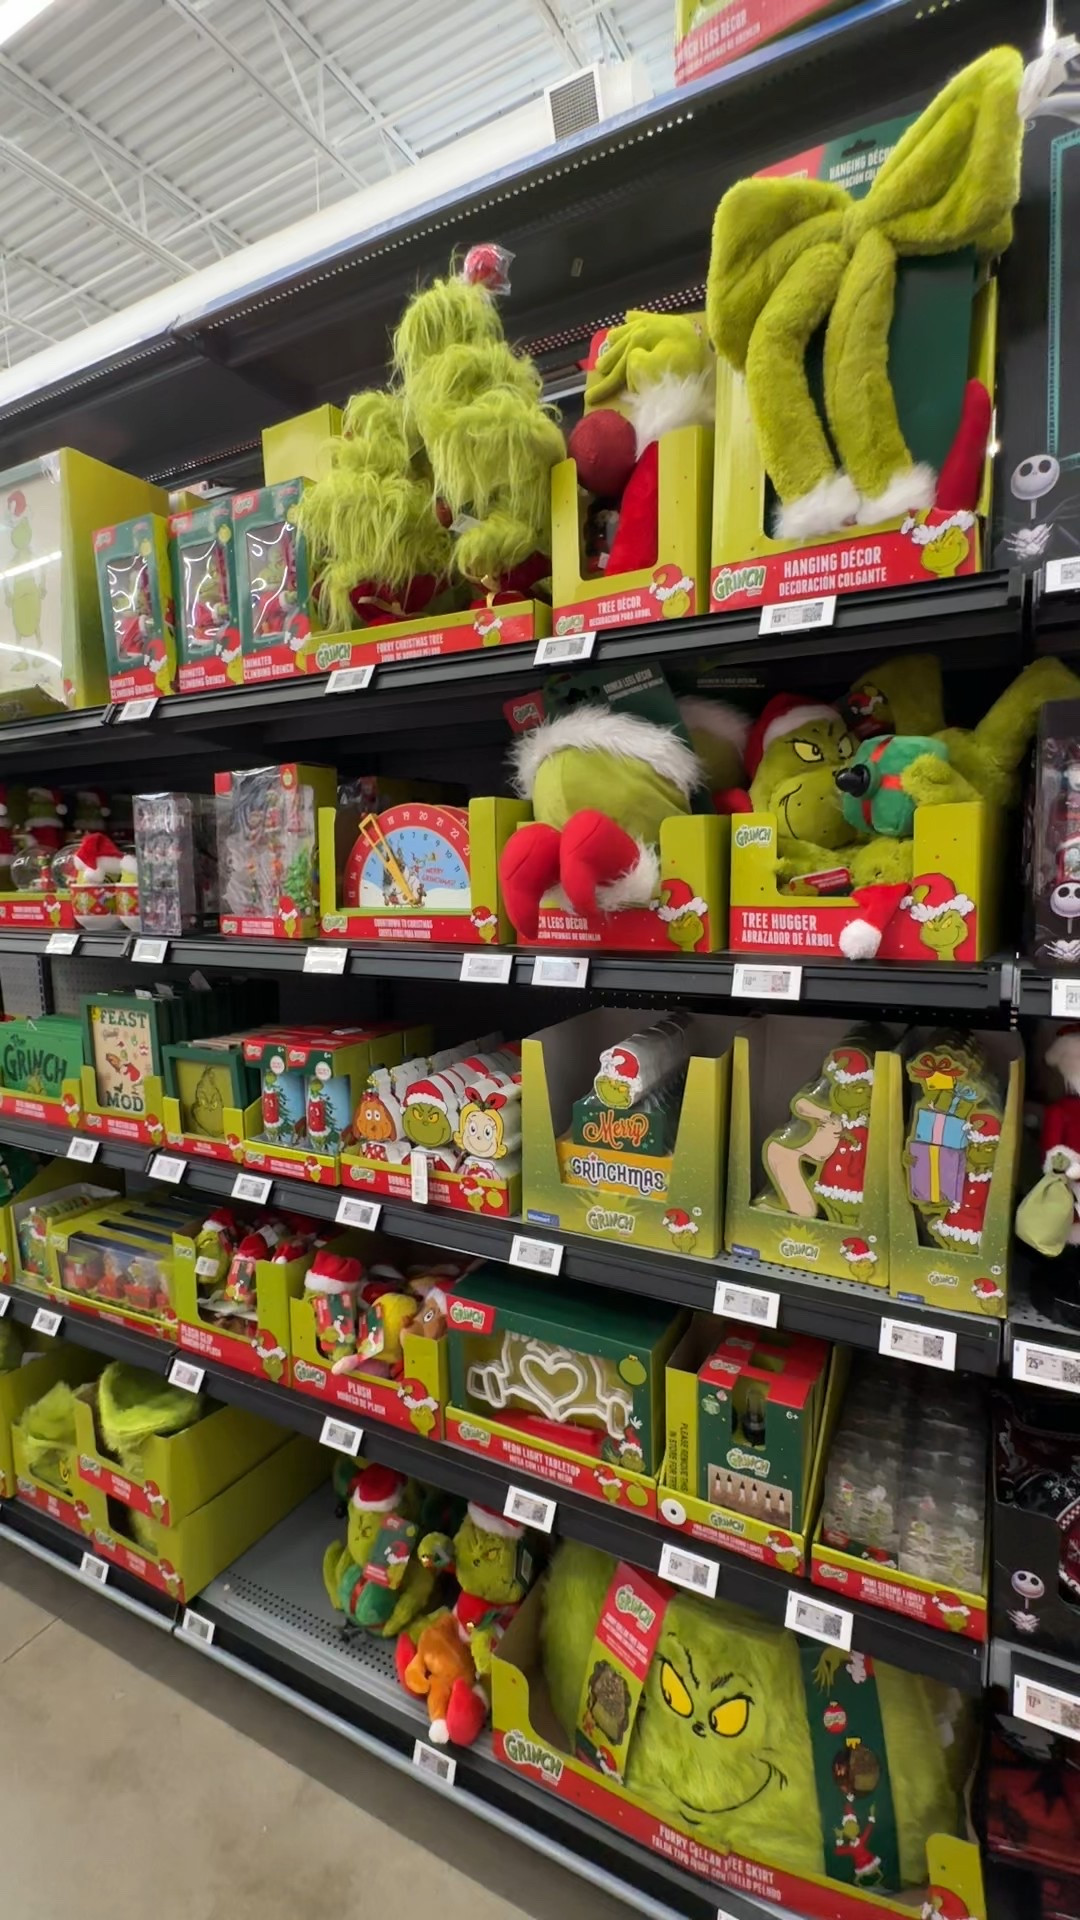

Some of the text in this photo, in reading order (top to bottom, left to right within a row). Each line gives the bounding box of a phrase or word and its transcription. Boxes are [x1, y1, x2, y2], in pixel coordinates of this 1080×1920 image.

[829, 155, 866, 181] HANGING
[783, 545, 882, 578] HANGING DÉCOR
[778, 566, 888, 597] DECORACIÓN COLGANTE
[596, 600, 616, 615] TREE
[546, 915, 565, 929] LEGS
[742, 911, 817, 931] TREE HUGGER
[741, 929, 835, 948] ABRAZADOR DE ÁRBOL
[100, 1008, 148, 1029] FEAST
[4, 1043, 68, 1084] GRINCH
[105, 1090, 144, 1113] MOD
[583, 1109, 649, 1150] Merry
[572, 1154, 666, 1195] GRINCHMAS
[587, 1209, 636, 1232] GRINCH
[786, 1411, 798, 1421] 6+
[502, 1439, 522, 1456] NEON
[522, 1445, 543, 1464] LIGHT
[504, 1734, 563, 1780] GRINCH
[659, 1824, 689, 1850] FURRY
[744, 1862, 774, 1885] SKIRT
